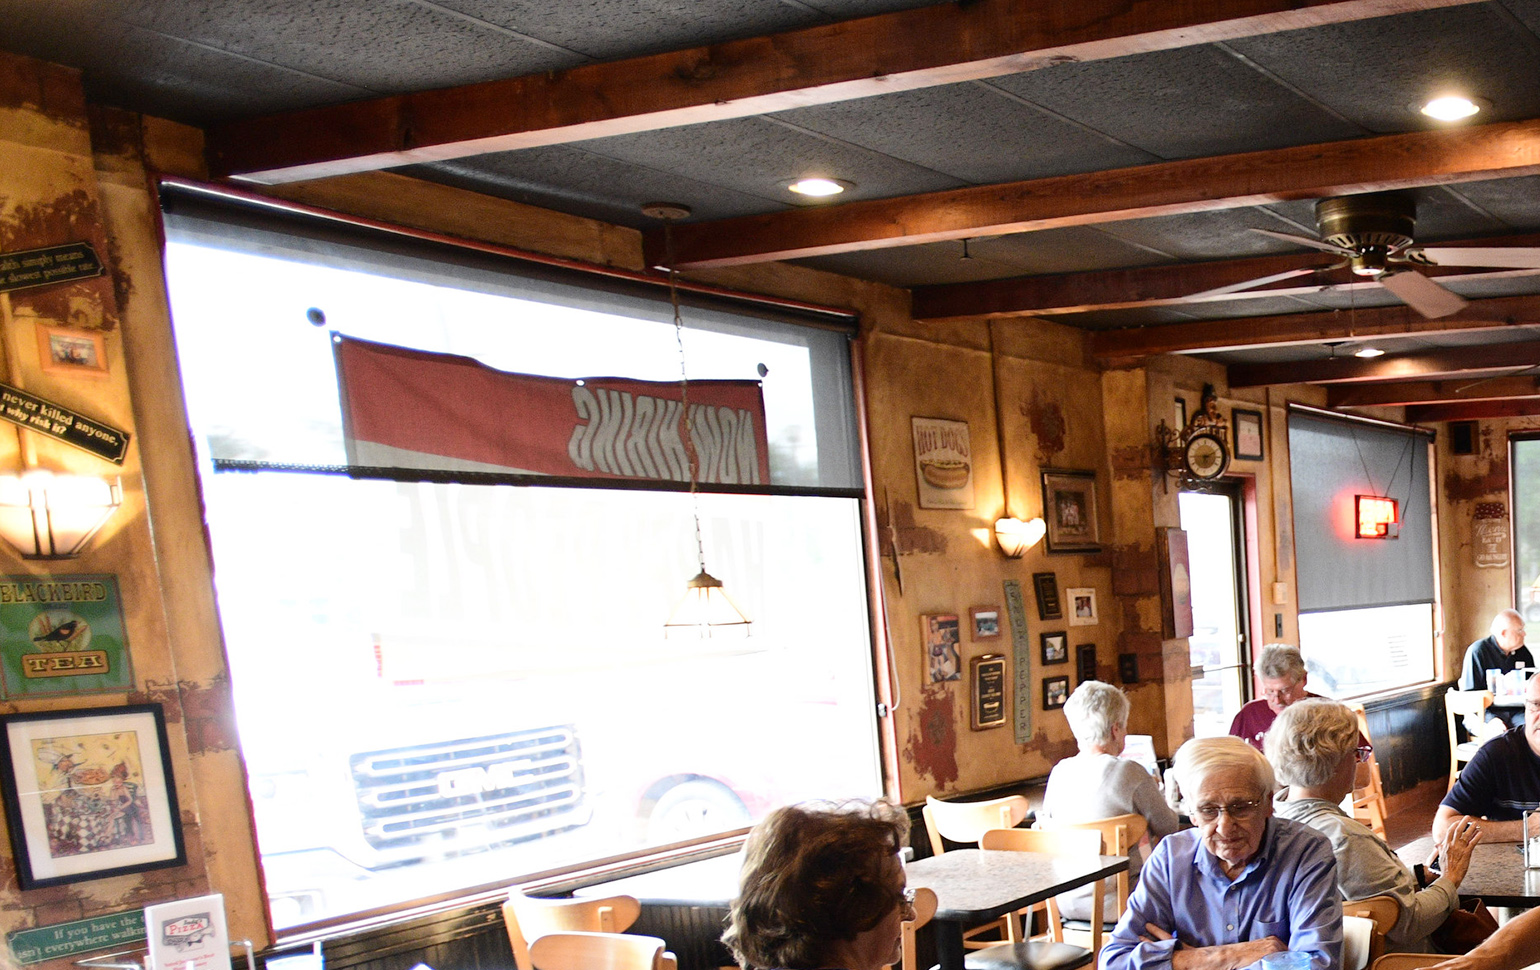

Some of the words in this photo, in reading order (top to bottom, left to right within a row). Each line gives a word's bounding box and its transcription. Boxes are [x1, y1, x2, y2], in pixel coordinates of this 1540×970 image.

[3, 392, 39, 412] never
[40, 404, 74, 426] killed
[75, 420, 119, 447] anyone,
[6, 406, 29, 422] why
[29, 415, 51, 429] risk
[916, 425, 938, 456] HOT
[941, 426, 969, 458] DOGS
[0, 582, 106, 604] BLACKBIRD
[28, 655, 103, 672] TEA
[437, 759, 534, 799] GMC
[53, 930, 64, 940] If
[66, 926, 89, 941] you
[91, 921, 118, 933] have
[120, 915, 138, 928] the
[169, 923, 204, 935] PIZZA
[44, 935, 110, 954] everywhere
